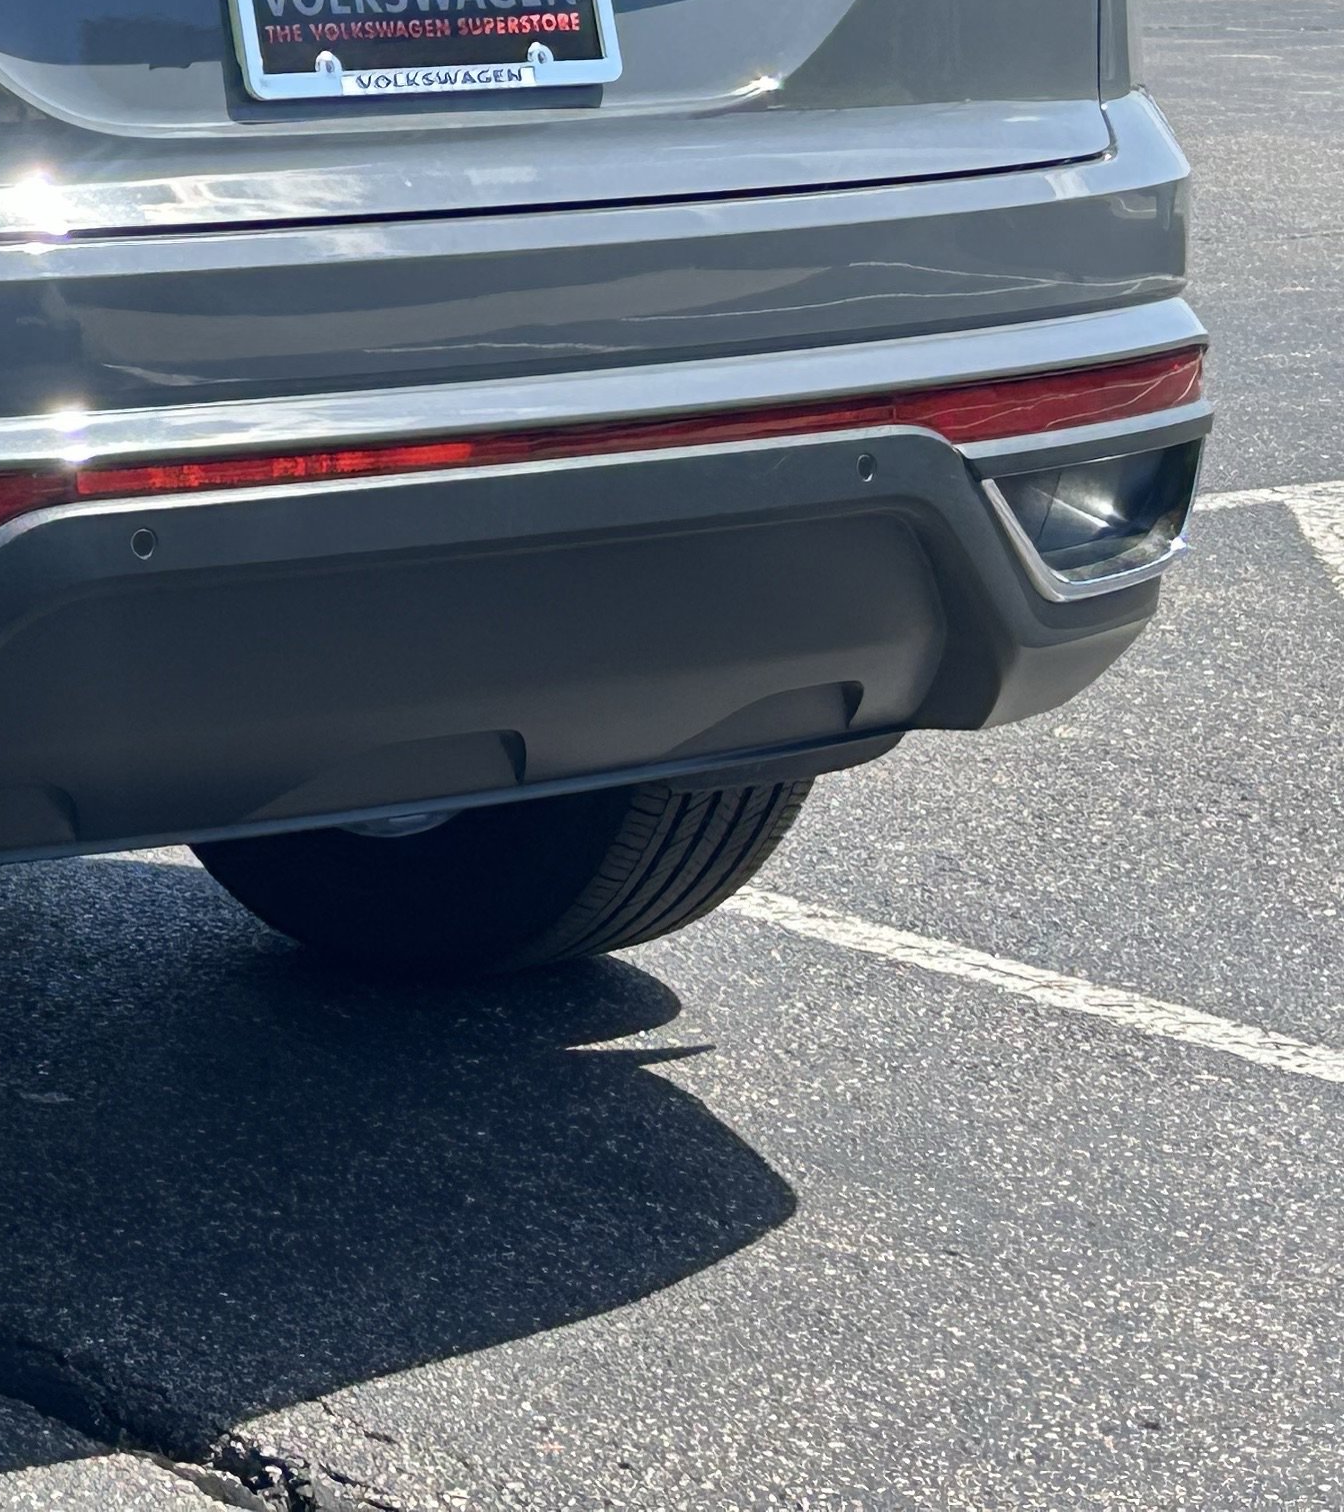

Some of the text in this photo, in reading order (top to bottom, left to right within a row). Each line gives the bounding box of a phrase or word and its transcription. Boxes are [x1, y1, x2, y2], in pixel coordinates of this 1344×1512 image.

[265, 12, 582, 44] THE VOLKSWAGEN SUPERSTORE
[355, 68, 523, 90] VOLKSWAGEN
